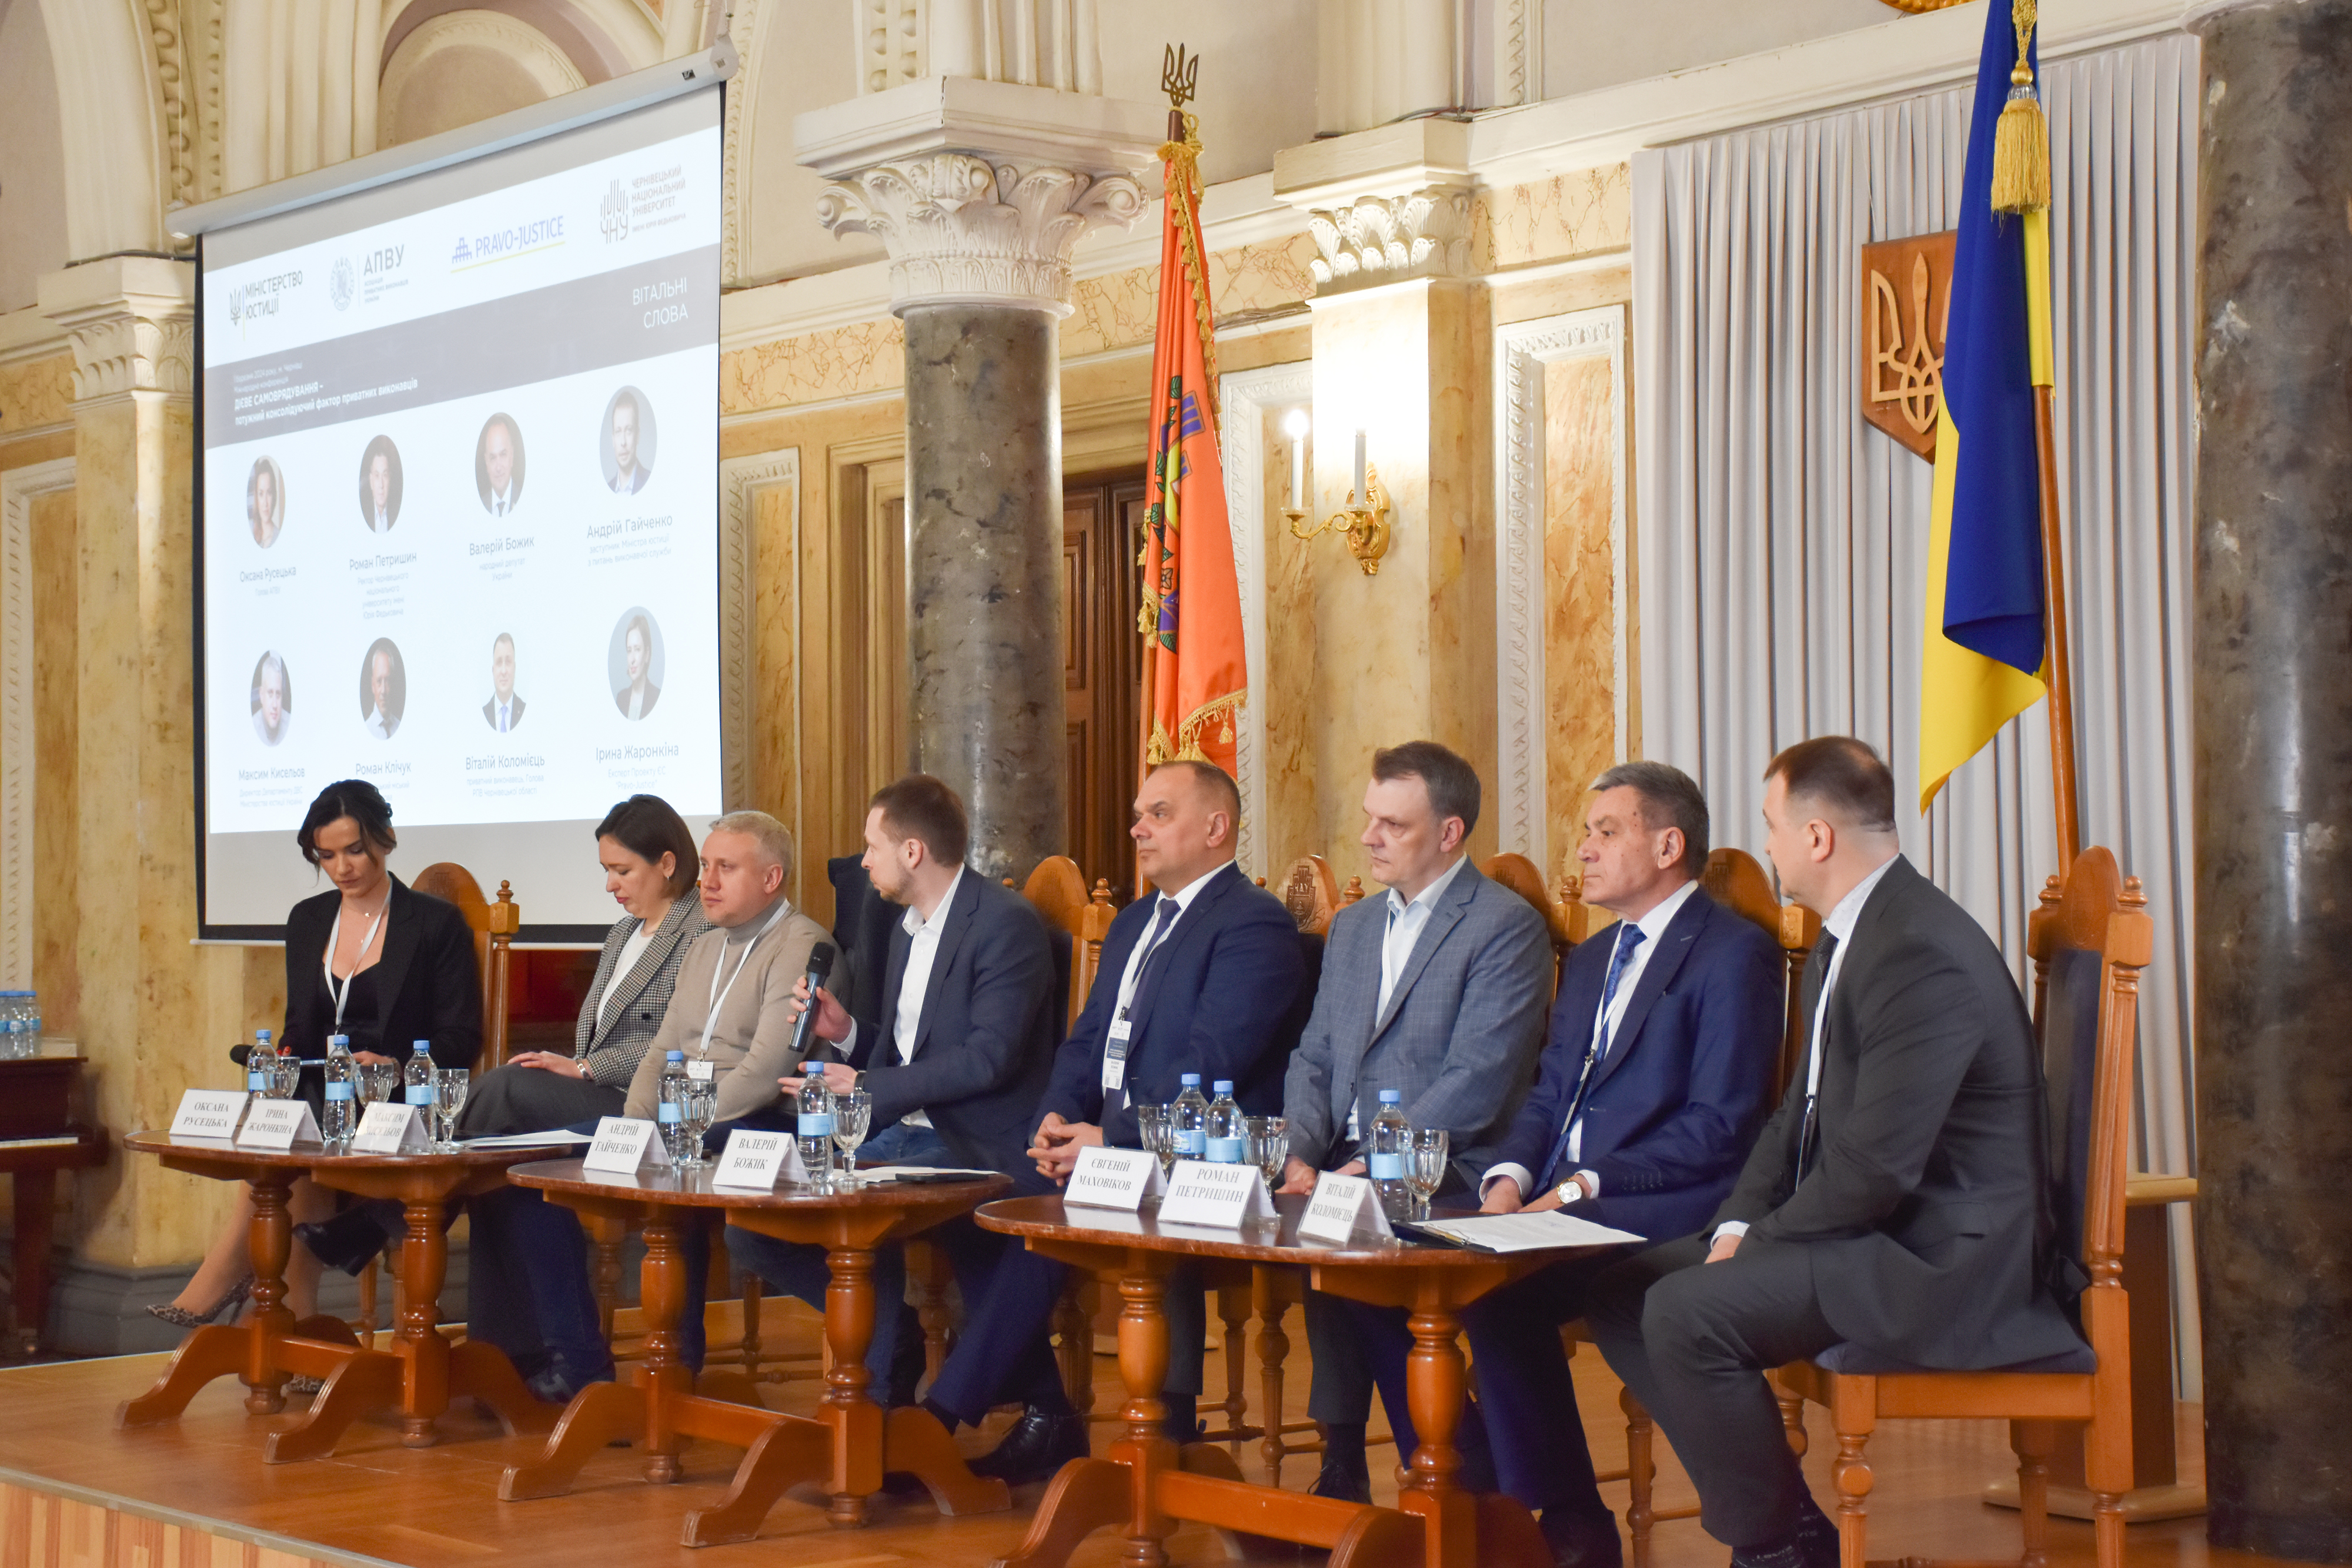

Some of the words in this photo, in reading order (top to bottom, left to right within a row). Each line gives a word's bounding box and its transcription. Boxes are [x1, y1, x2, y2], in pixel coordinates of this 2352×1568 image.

[632, 163, 681, 189] ЧЕРНІВЕЦЬКИЙ
[632, 177, 686, 203] НАЦІОНАЛЬНИЙ
[632, 196, 675, 217] УНІВЕРСИТЕТ
[476, 215, 564, 258] PRAVO-JUSTICE
[600, 214, 628, 245] ЧНУ
[363, 243, 405, 276] АПВУ
[245, 270, 303, 299] МІНІСТЕРСТВО
[633, 276, 687, 305] ВІТАЛЬНІ
[246, 293, 279, 320] ЮСТИЦІЇ
[644, 303, 689, 329] СЛОВА
[235, 409, 265, 426] потужний
[266, 398, 315, 419] консолідуючий
[316, 396, 341, 410] фактор
[342, 388, 377, 404] приватних
[378, 377, 418, 396] виконавців
[254, 381, 319, 406] САМОВРЯДУВАННЯ
[587, 520, 622, 539] Андрій
[625, 515, 673, 533] Гайченко
[469, 538, 503, 556] Валерій
[506, 536, 534, 551] Божик
[349, 559, 374, 571] Роман
[376, 552, 417, 569] Петришин
[240, 571, 263, 583] Оксана
[265, 566, 296, 582] Русецька
[466, 755, 495, 770] Віталій
[498, 753, 545, 768] Коломієць
[596, 747, 622, 764] Ірина
[624, 741, 679, 762] Жаронкіна
[239, 769, 269, 781] Максим
[270, 767, 305, 778] Кисельов
[356, 763, 383, 775] Роман
[385, 760, 412, 776] Клічук
[195, 1102, 229, 1112] ОКСАНА
[265, 1109, 288, 1119] ІРИНА
[183, 1116, 227, 1127] РУСЕЦЬКА
[248, 1122, 292, 1134] ЖАРОНКІНА
[607, 1123, 639, 1136] АНДРІЙ
[595, 1139, 637, 1155] ГАЙЧЕНКО
[739, 1137, 778, 1150] ВАЛЕРІЙ
[733, 1157, 768, 1169] БОЖИК
[1091, 1158, 1131, 1172] ЄВГЕНІЙ
[1077, 1175, 1131, 1191] МАХОВІКОВ
[1197, 1168, 1240, 1183] РОМАН
[1175, 1185, 1244, 1202] ПЕТРИШИН
[1326, 1183, 1357, 1199] ВІТАЛІЙ
[1311, 1203, 1353, 1222] КОЛОМІЄЦЬ
